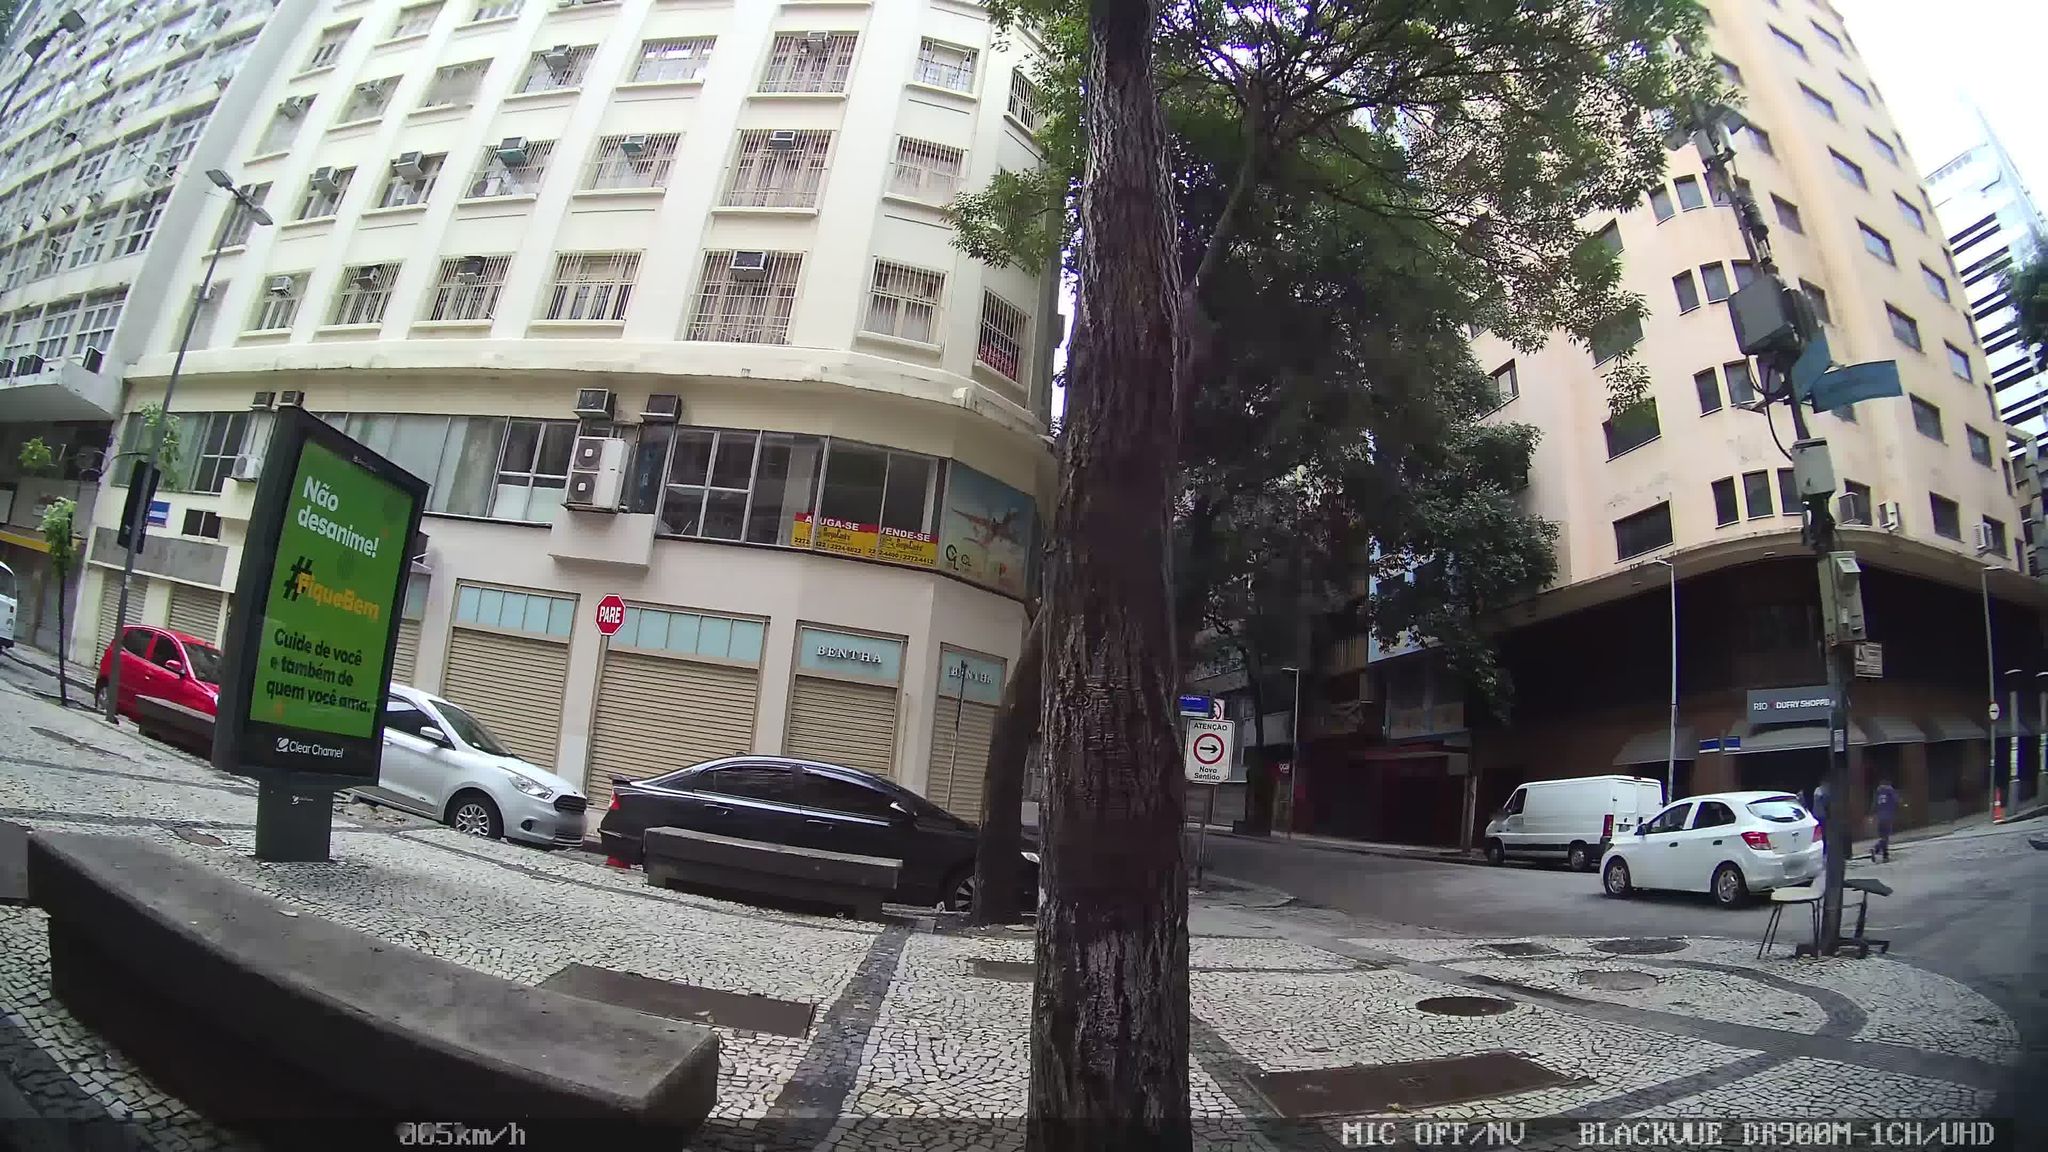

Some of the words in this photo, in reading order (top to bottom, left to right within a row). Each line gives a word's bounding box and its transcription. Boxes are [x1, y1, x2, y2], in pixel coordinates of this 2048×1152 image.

[303, 475, 339, 512] Não
[297, 505, 379, 558] desanime!
[805, 515, 860, 531] AUGA-SE
[880, 527, 931, 543] VENDE-SE
[599, 606, 622, 624] PARE
[274, 628, 312, 654] Cuide
[315, 640, 331, 659] de
[333, 650, 363, 666] você
[816, 645, 882, 664] BENTHA
[270, 656, 278, 670] e
[281, 656, 336, 683] também
[338, 670, 354, 687] de
[266, 679, 304, 700] quem
[308, 690, 337, 706] você
[1753, 702, 1768, 711] RIO
[288, 740, 313, 755] Clear
[312, 743, 344, 759] Channel
[1194, 772, 1221, 781] Sentido
